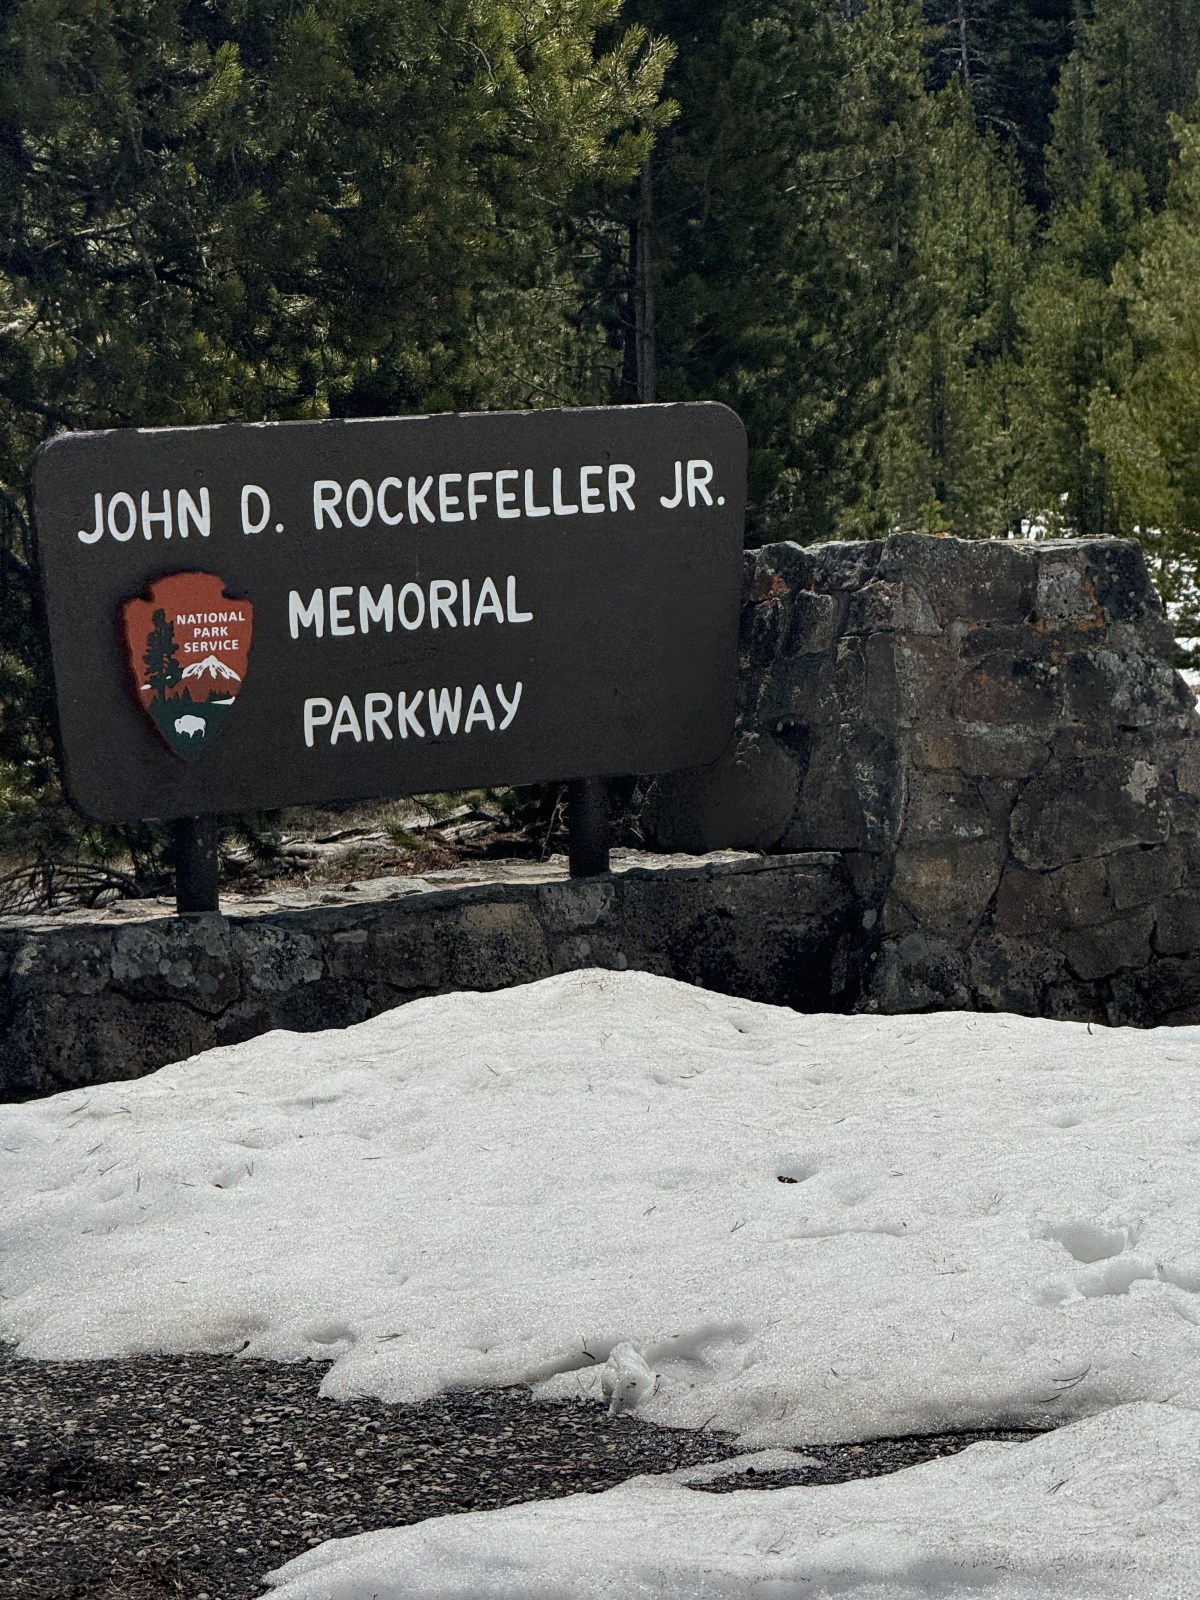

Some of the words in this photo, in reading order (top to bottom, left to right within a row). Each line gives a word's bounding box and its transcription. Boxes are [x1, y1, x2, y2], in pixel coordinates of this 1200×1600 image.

[77, 486, 211, 545] JOHN
[240, 484, 285, 535] D.
[313, 463, 636, 531] ROCKEFELLER
[659, 459, 726, 510] JR.
[176, 611, 246, 625] NATIONAL
[288, 574, 534, 640] MEMORIAL
[183, 639, 239, 653] SERVICE
[193, 626, 229, 638] PARK
[303, 681, 523, 748] PARKWAY
